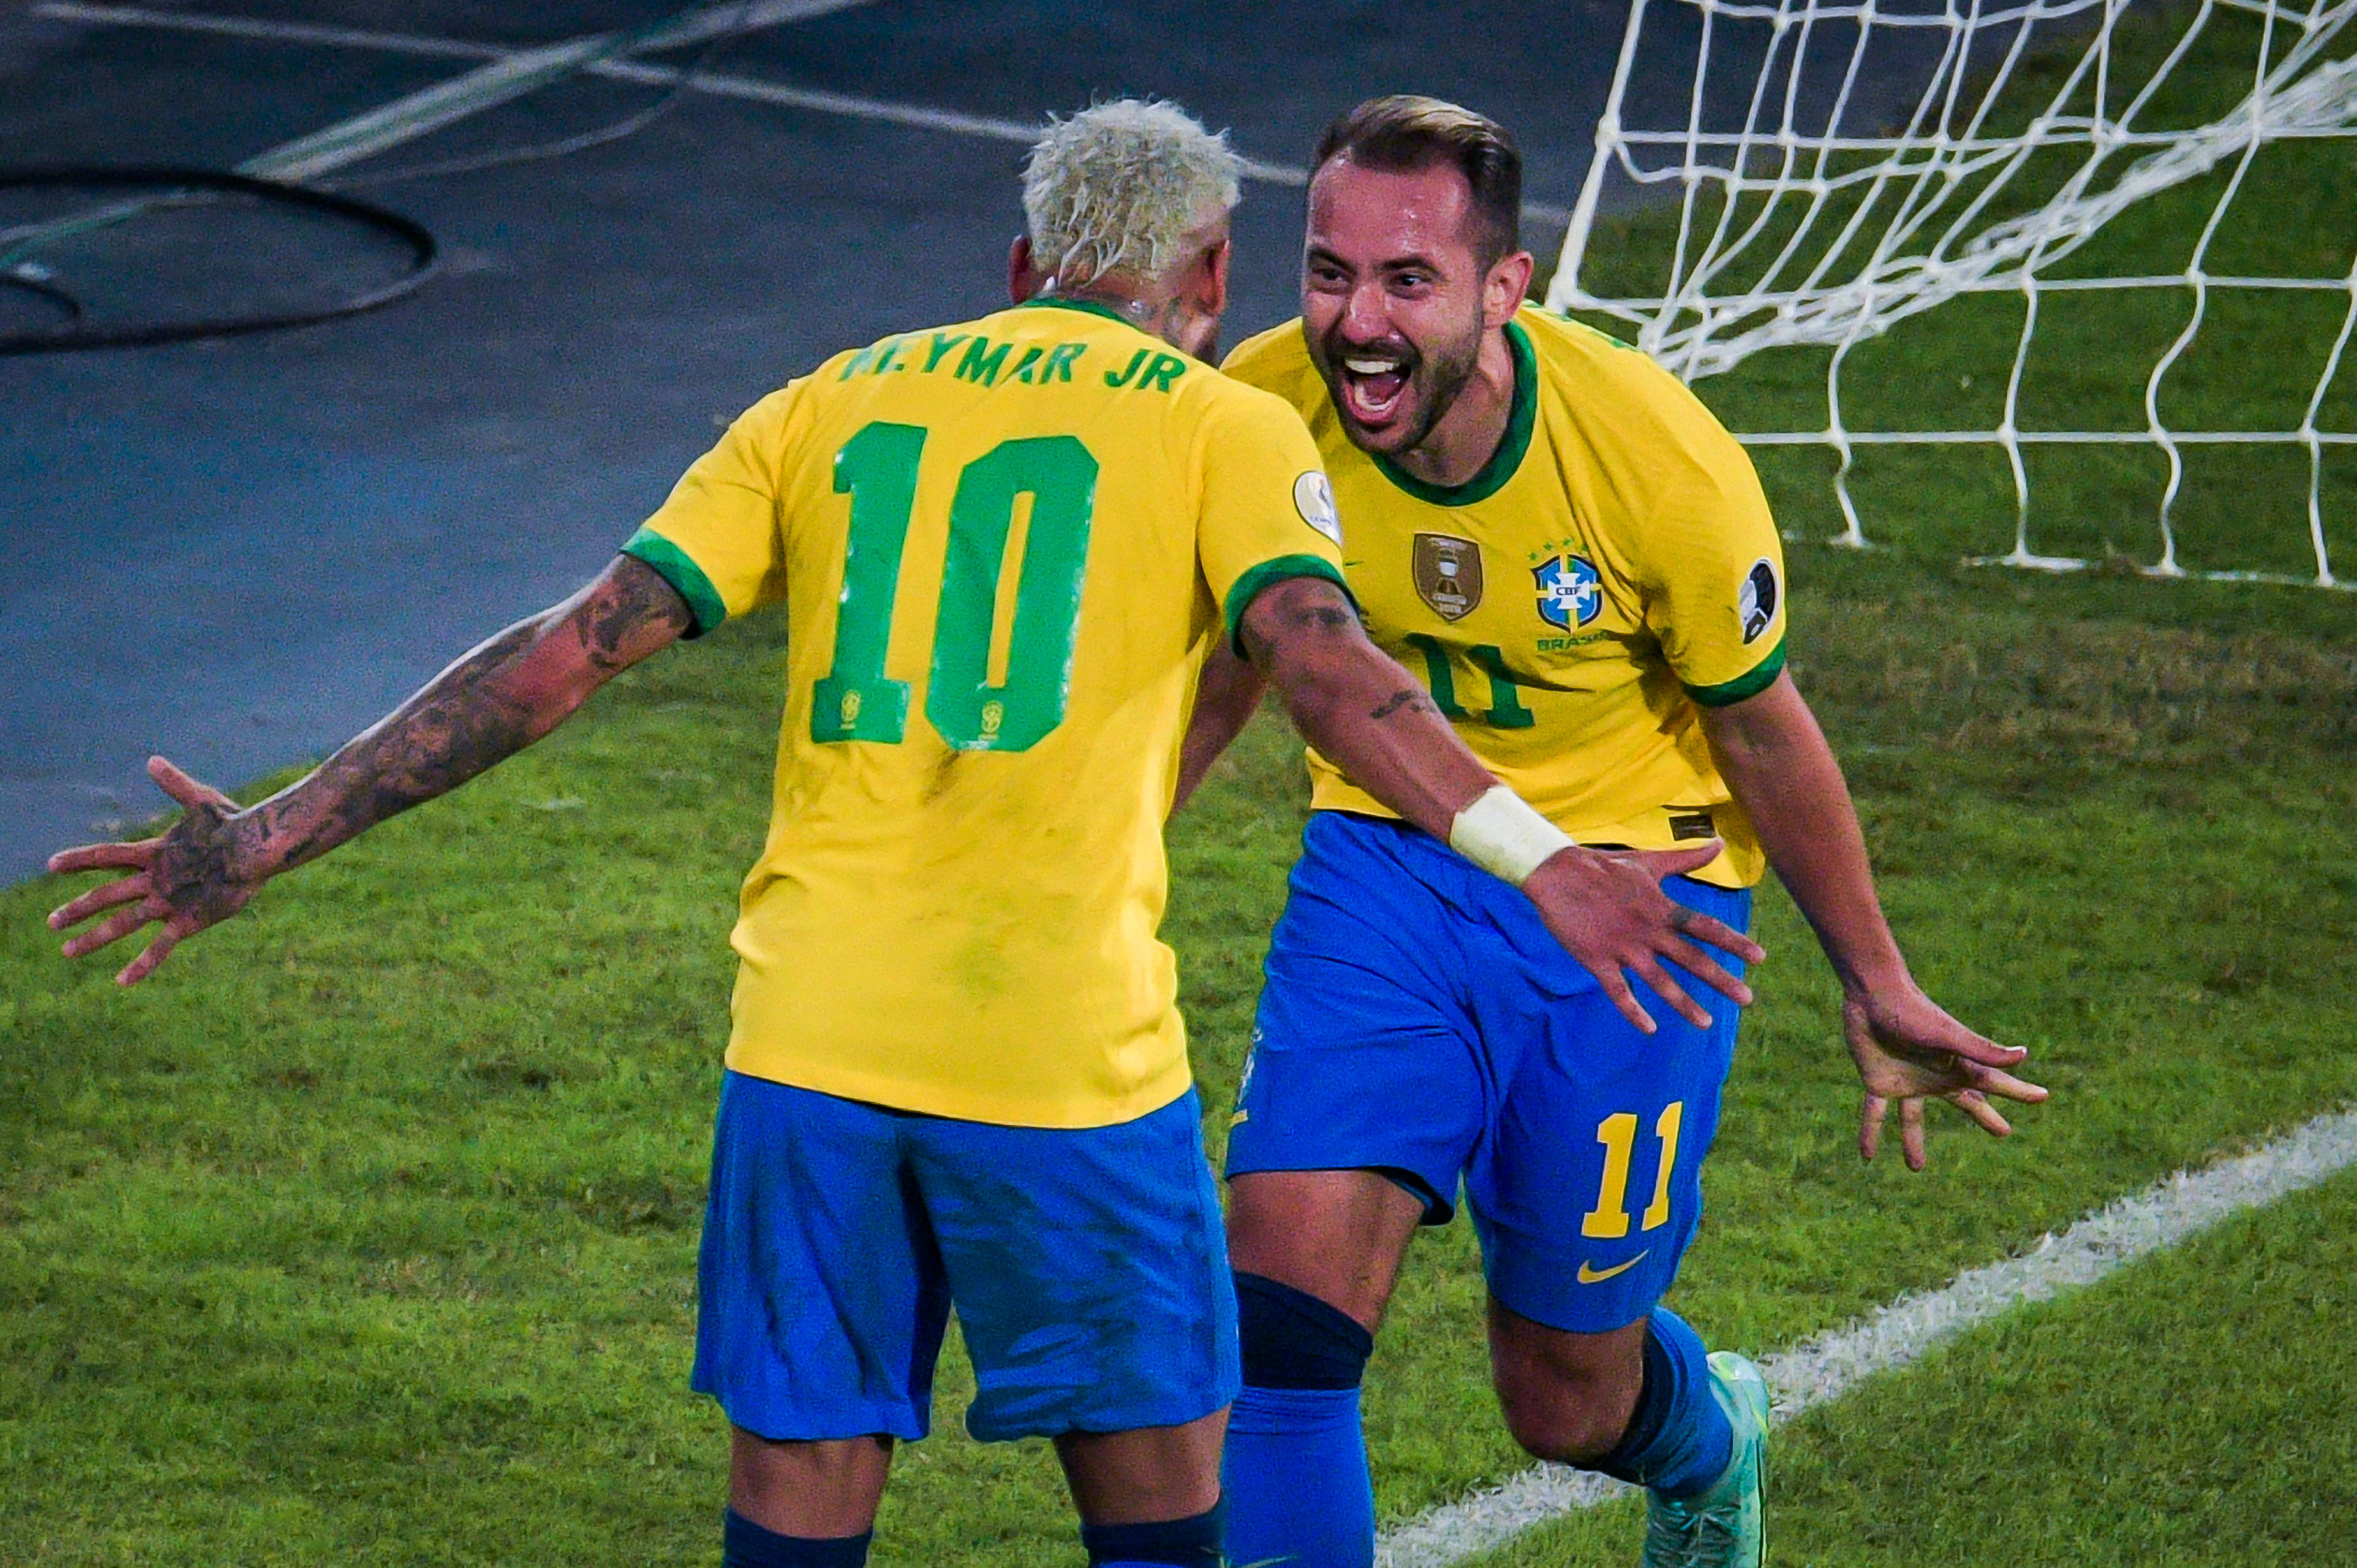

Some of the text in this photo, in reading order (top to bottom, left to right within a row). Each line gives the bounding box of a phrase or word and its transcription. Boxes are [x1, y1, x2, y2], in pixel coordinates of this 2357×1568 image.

[838, 332, 1186, 393] NEYMAR JR
[810, 421, 1099, 752] 10
[1403, 631, 1535, 729] 11
[1582, 1101, 1682, 1238] 11
